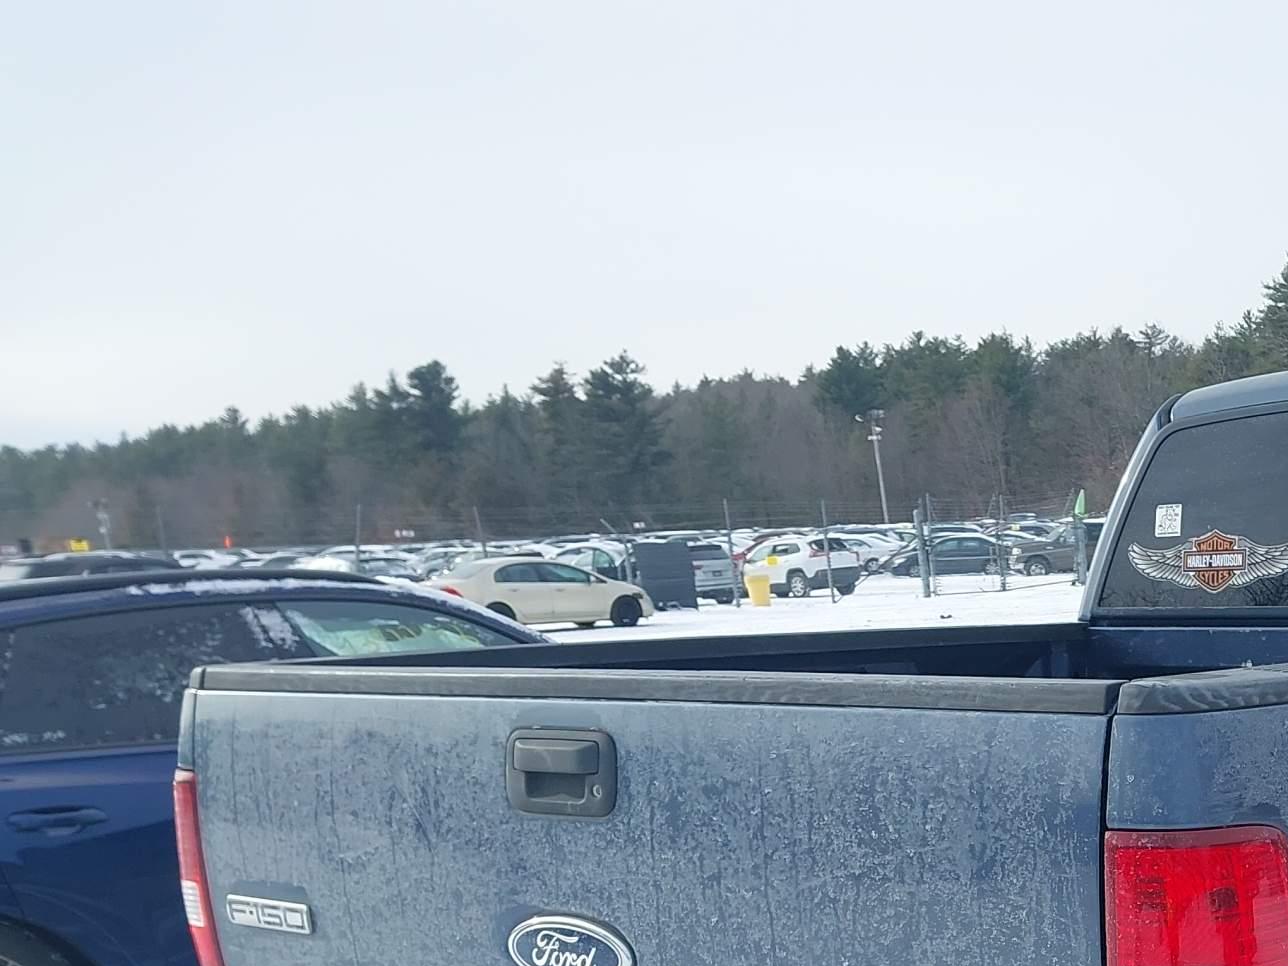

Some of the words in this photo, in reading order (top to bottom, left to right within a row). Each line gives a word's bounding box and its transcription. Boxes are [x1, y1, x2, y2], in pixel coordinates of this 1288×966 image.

[1200, 537, 1231, 551] MOTOR
[1187, 553, 1243, 568] HARLEY-DAVIDSON
[1200, 570, 1229, 586] CYCLES
